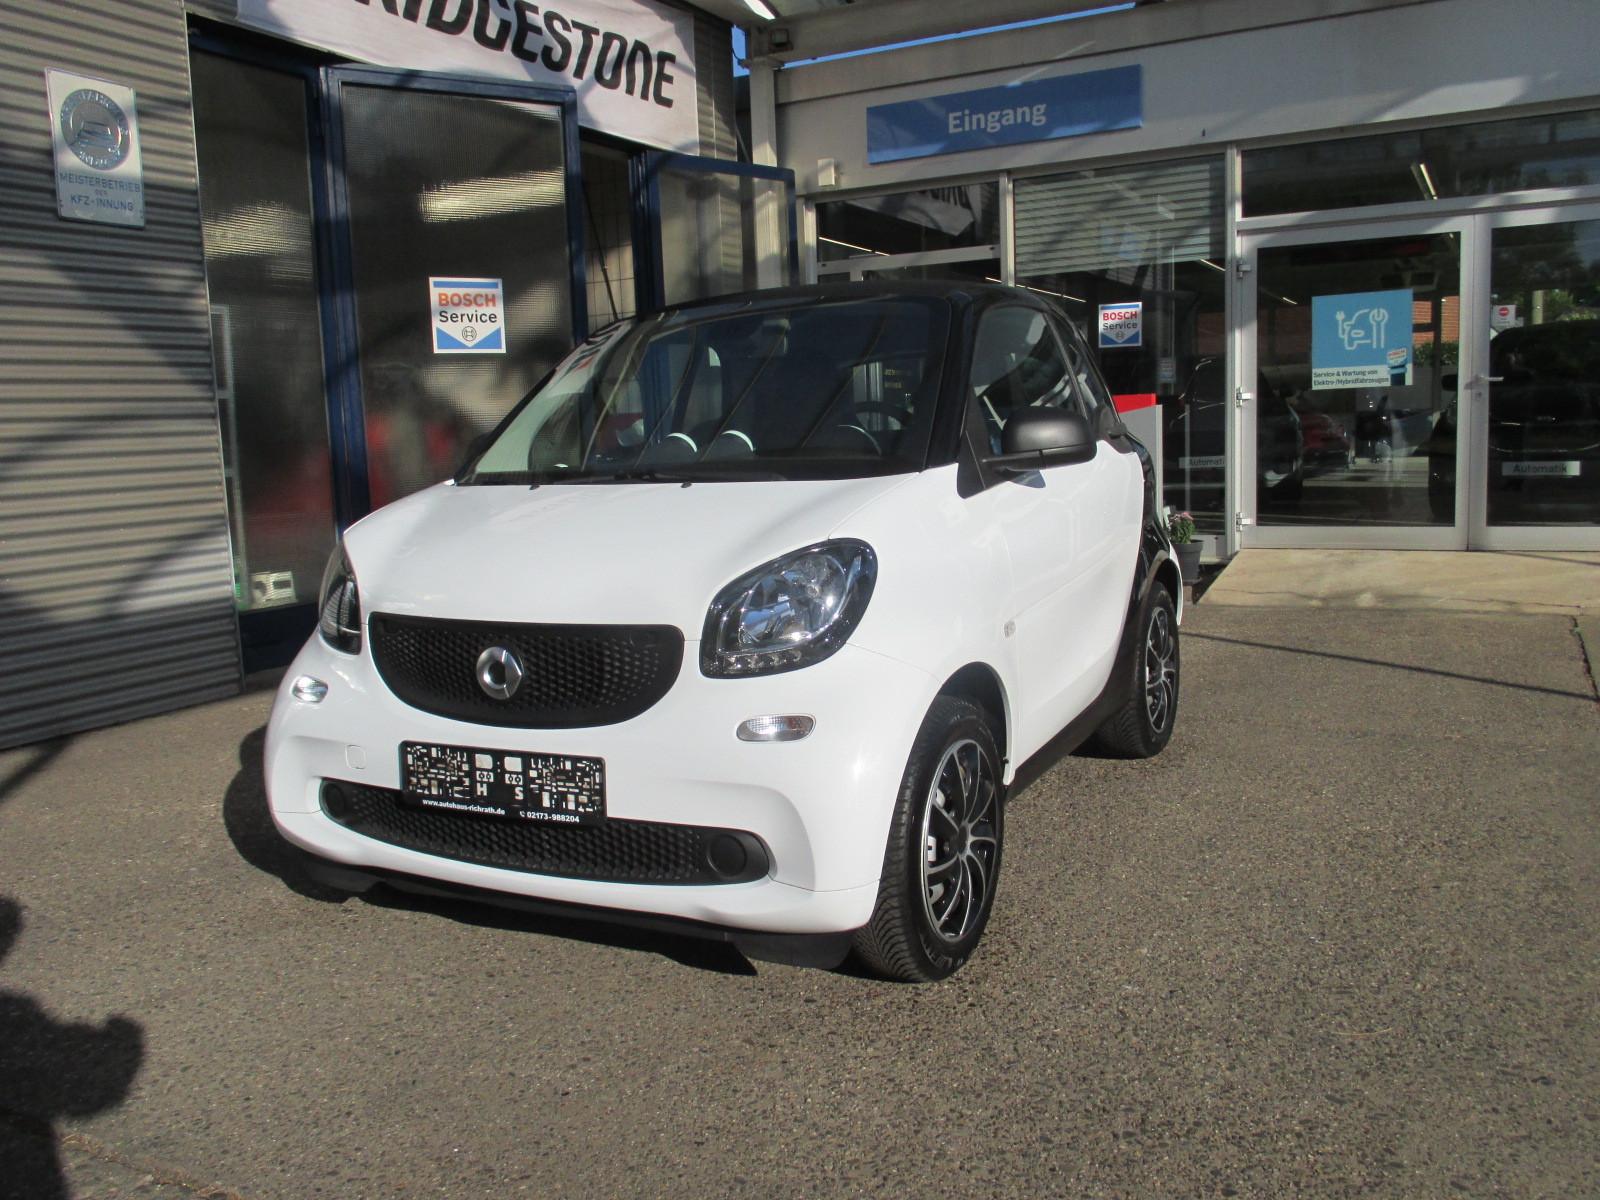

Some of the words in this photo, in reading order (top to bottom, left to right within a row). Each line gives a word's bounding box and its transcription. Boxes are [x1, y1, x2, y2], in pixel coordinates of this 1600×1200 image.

[948, 103, 1048, 134] Eingang
[59, 172, 141, 193] MEISTERBETRIEB
[70, 194, 134, 212] KFZ-INNUNG
[438, 292, 497, 308] BOSCH
[439, 309, 498, 323] Service
[1102, 311, 1138, 321] BOSCH
[1102, 321, 1138, 331] Service
[1342, 369, 1367, 377] Wartung
[1512, 463, 1568, 473] Automatik
[422, 799, 506, 816] www.autohaus-richrath.de
[526, 811, 580, 823] 02173-988204
